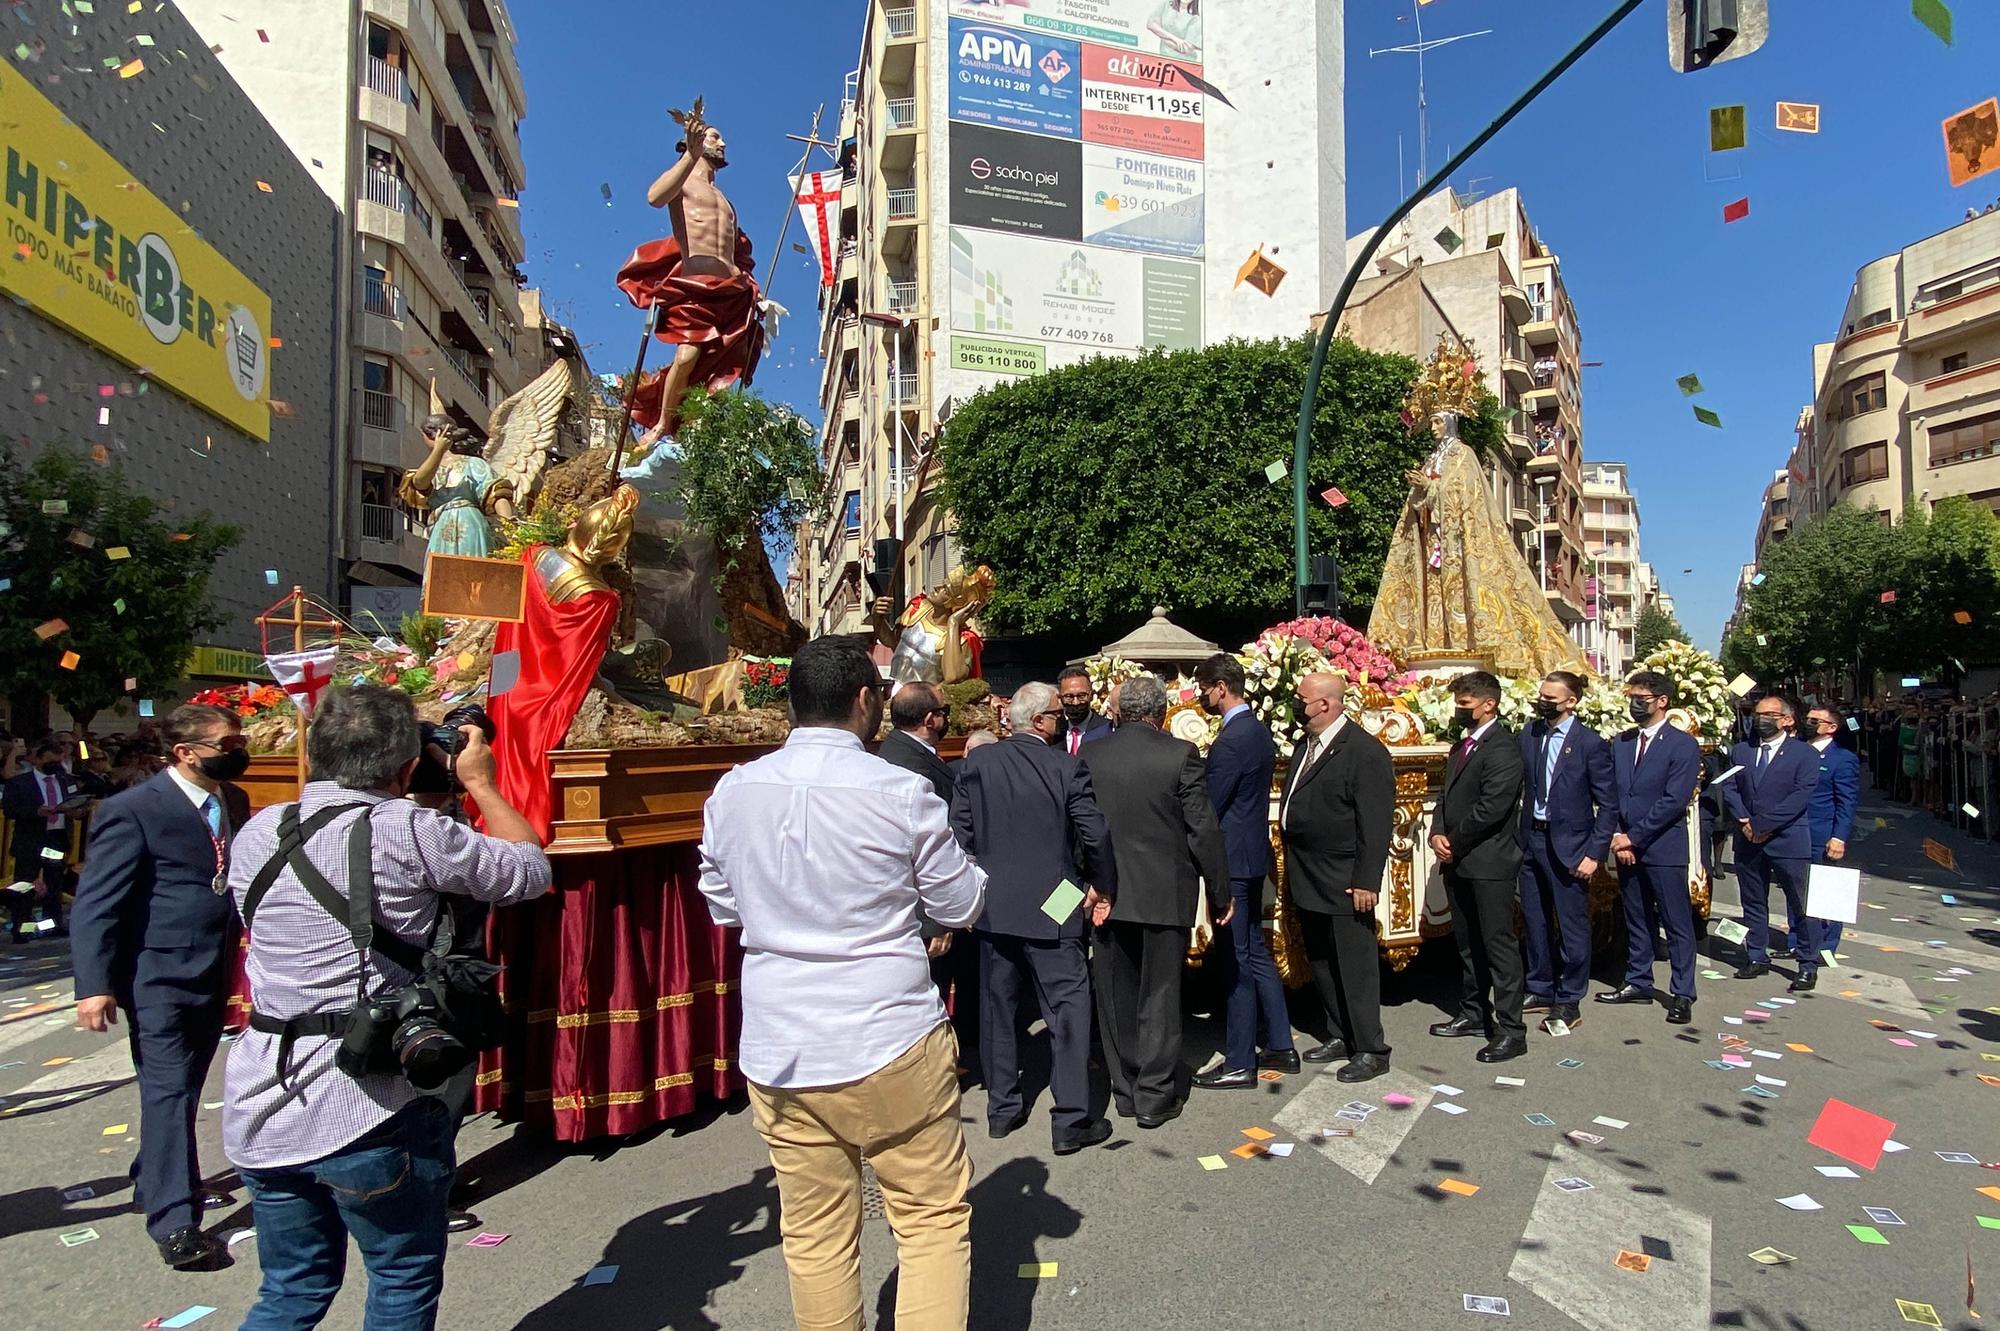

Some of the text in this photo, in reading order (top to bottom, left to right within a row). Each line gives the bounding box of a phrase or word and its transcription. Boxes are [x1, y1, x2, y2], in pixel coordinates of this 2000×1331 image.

[1064, 0, 1098, 12] FASCITIS
[1026, 15, 1088, 35] 966 09 12 65
[1064, 9, 1130, 28] CALCIFICACIONES
[958, 32, 1032, 69] APM
[958, 58, 1032, 77] ADMINISTRADORES
[1107, 55, 1175, 87] akiwifi
[973, 73, 1031, 93] 966 613 289
[1085, 88, 1145, 104] INTERNET
[1146, 95, 1201, 116] 11,95€
[1101, 101, 1130, 112] DESDE
[996, 165, 1058, 187] sacha piel
[1115, 157, 1196, 182] FONTANERIA
[1123, 174, 1192, 195] Domingo Nieto Ruiz
[1141, 199, 1166, 213] 601
[5, 145, 216, 349] HIPERBER
[7, 217, 49, 261] TODO
[88, 273, 136, 318] BARATO
[1040, 326, 1114, 343] 677 409 768
[960, 343, 1036, 358] PUBLICIDAD VERTICAL
[960, 352, 1036, 370] 966 110 800
